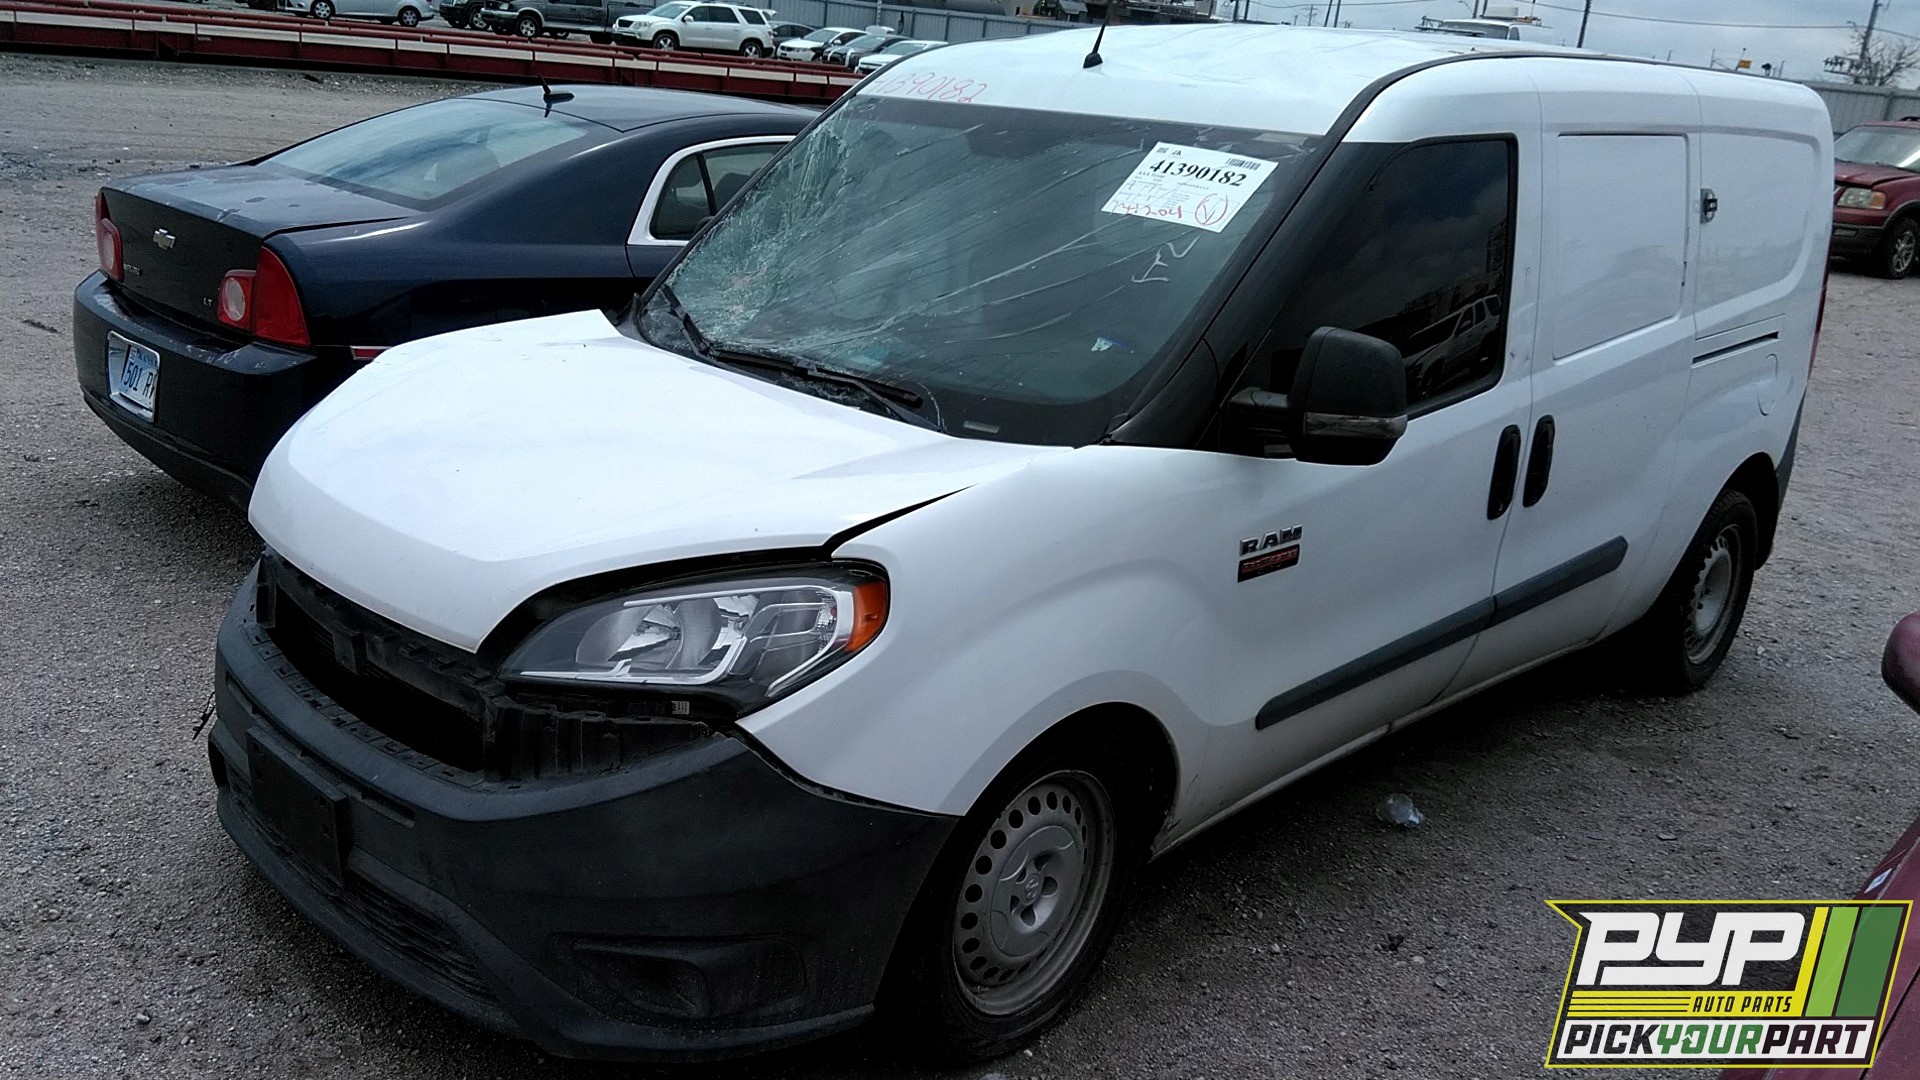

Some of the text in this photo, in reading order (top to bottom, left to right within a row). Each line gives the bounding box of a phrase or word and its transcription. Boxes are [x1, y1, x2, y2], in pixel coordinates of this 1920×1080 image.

[1150, 160, 1247, 187] 41390182
[124, 361, 143, 392] 501
[1239, 524, 1302, 556] RAM
